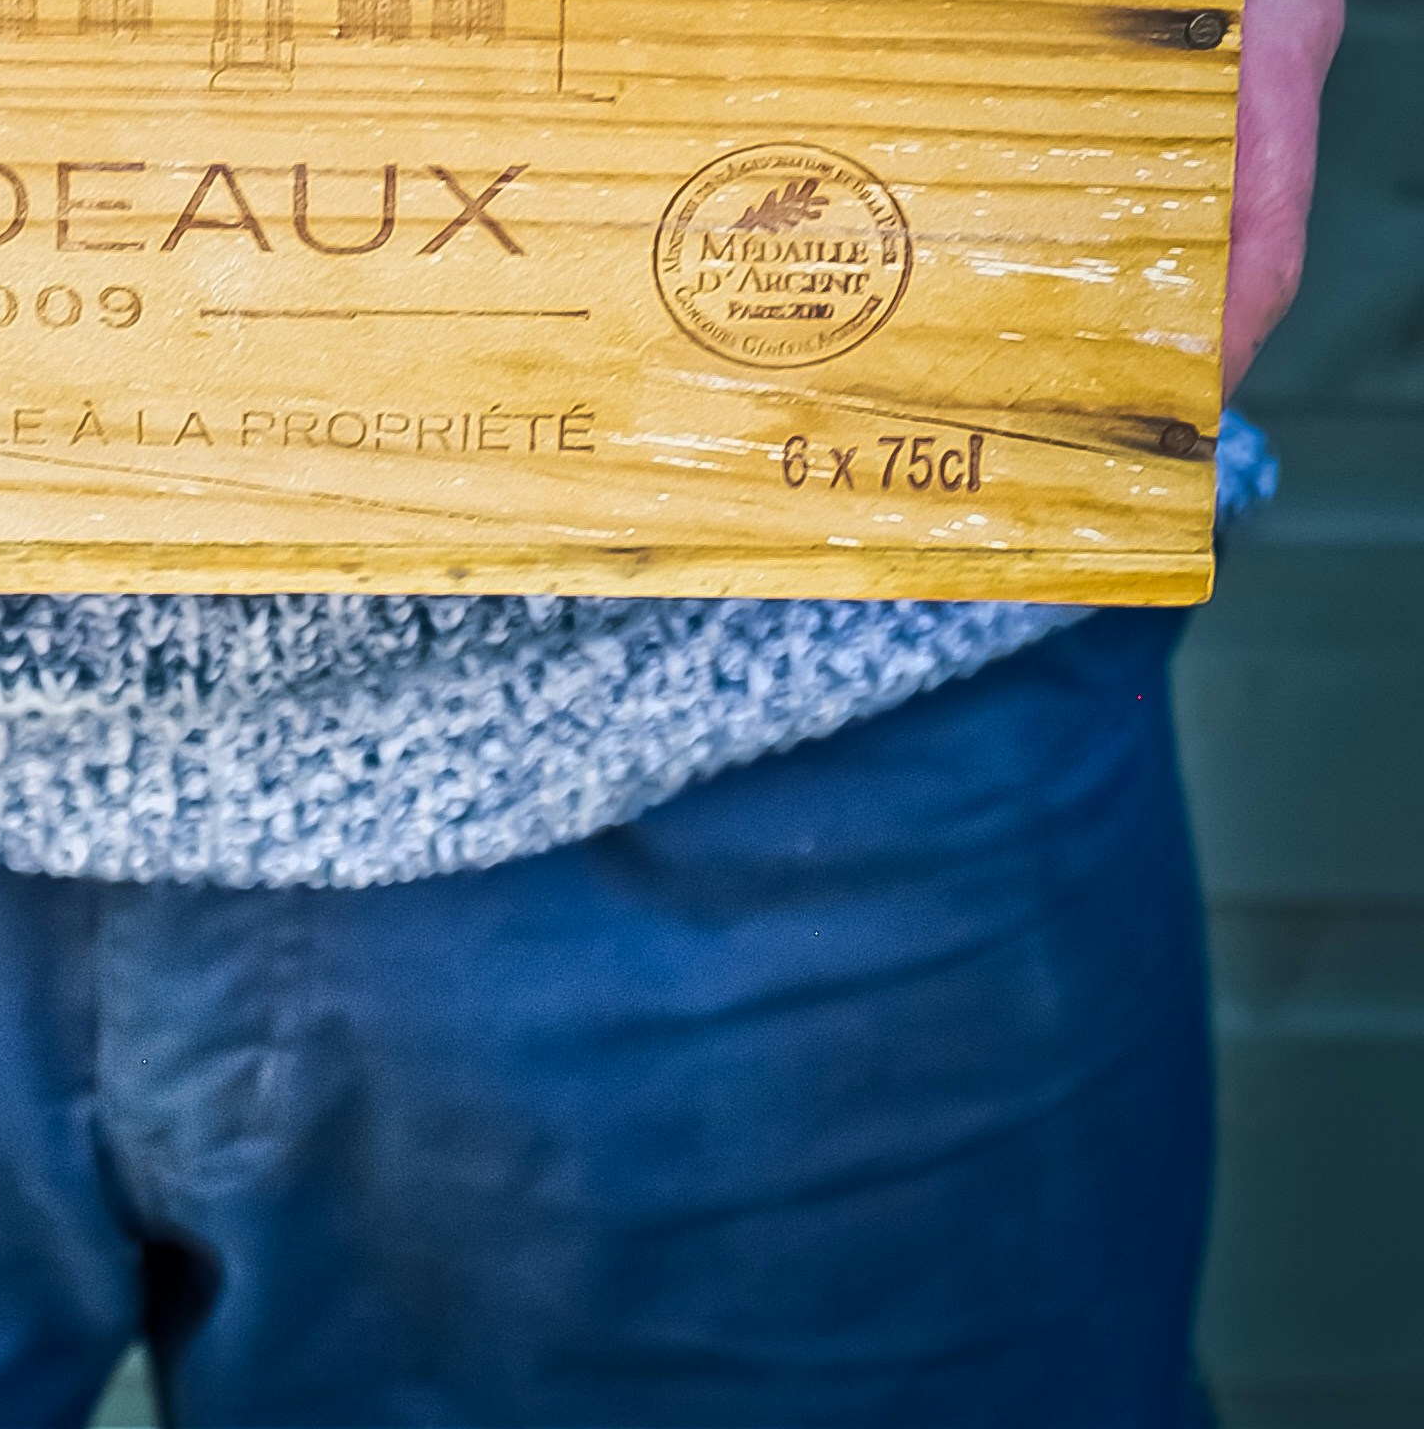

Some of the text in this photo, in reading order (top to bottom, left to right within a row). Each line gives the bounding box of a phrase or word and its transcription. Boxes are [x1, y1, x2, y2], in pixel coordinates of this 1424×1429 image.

[72, 400, 109, 447] À
[136, 409, 215, 448] LA
[241, 403, 596, 453] PROPRIÉTÉ
[781, 434, 984, 493] 6 x 75cl
